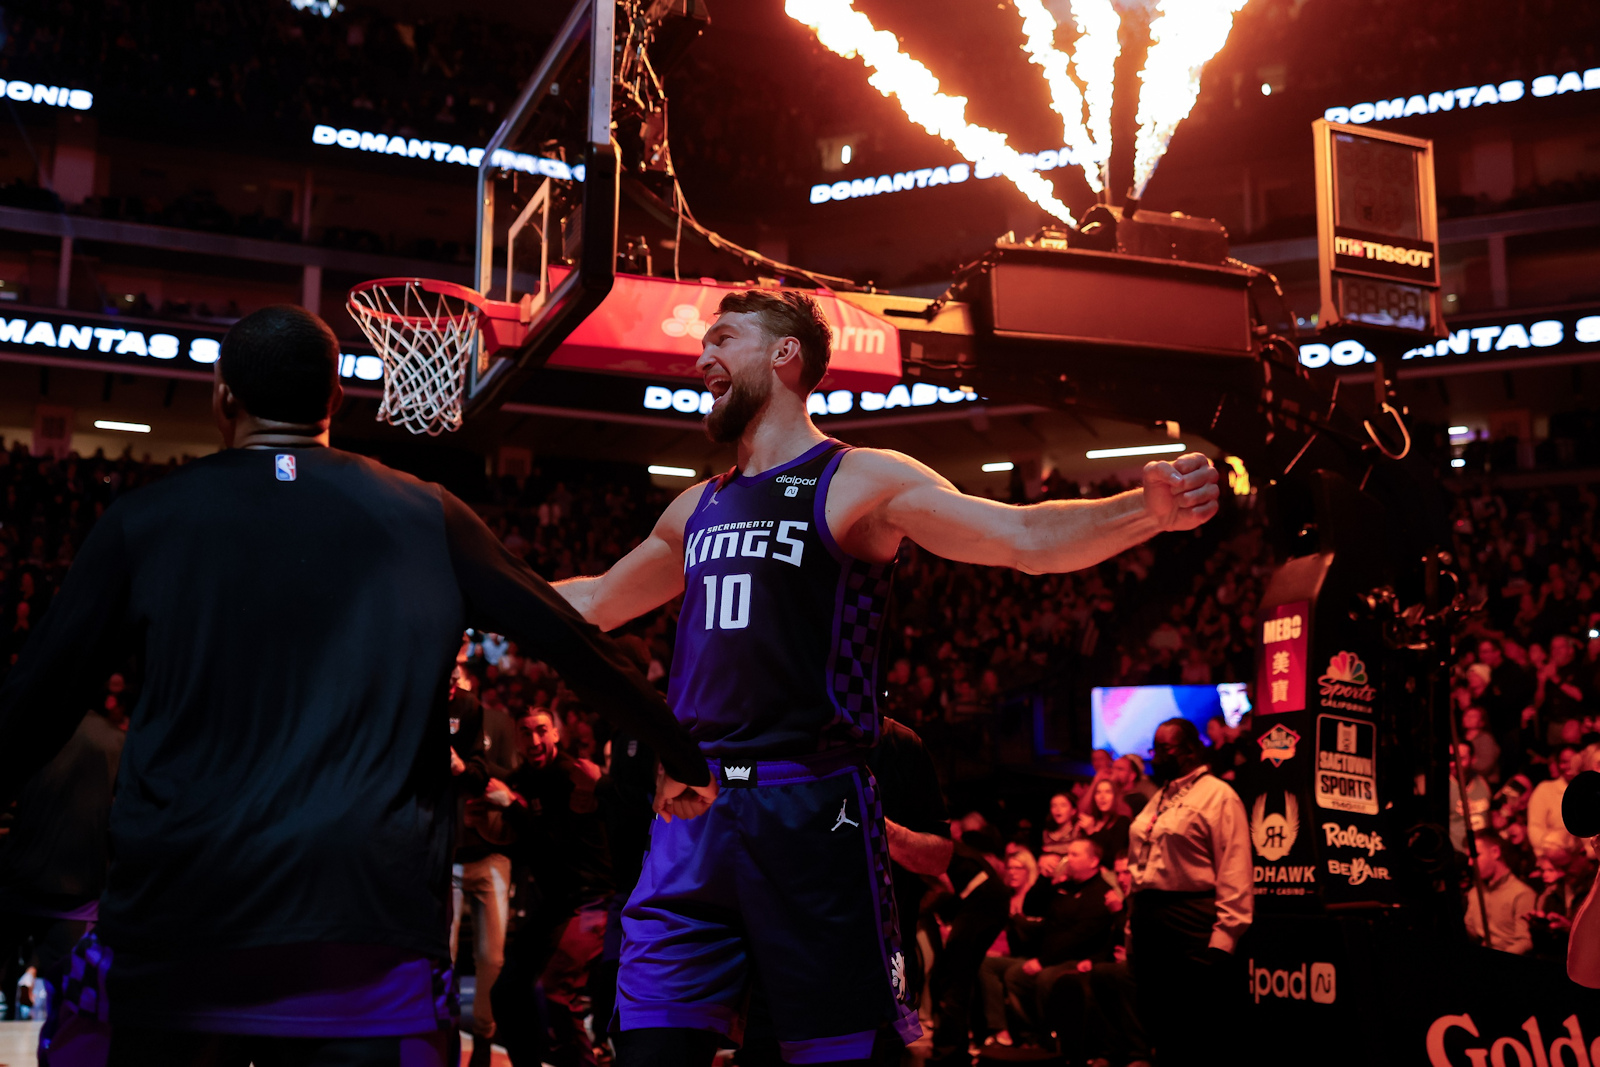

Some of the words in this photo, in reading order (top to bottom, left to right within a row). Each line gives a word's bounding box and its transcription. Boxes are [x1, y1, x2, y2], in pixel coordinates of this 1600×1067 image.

[0, 78, 94, 111] ONIS
[1323, 79, 1525, 125] DOMANTAS
[312, 124, 486, 168] DOMANTAS
[810, 164, 970, 205] DOMANTAS
[1362, 241, 1434, 269] TISSOT
[775, 475, 818, 486] dialpad
[707, 520, 775, 534] SACRAMENTO
[703, 573, 751, 631] 10
[1263, 614, 1302, 644] MEBO
[1317, 674, 1377, 702] Sports
[1319, 750, 1373, 777] SACTOWN
[1321, 775, 1373, 800] SPORTS
[1321, 821, 1387, 857] Raley's
